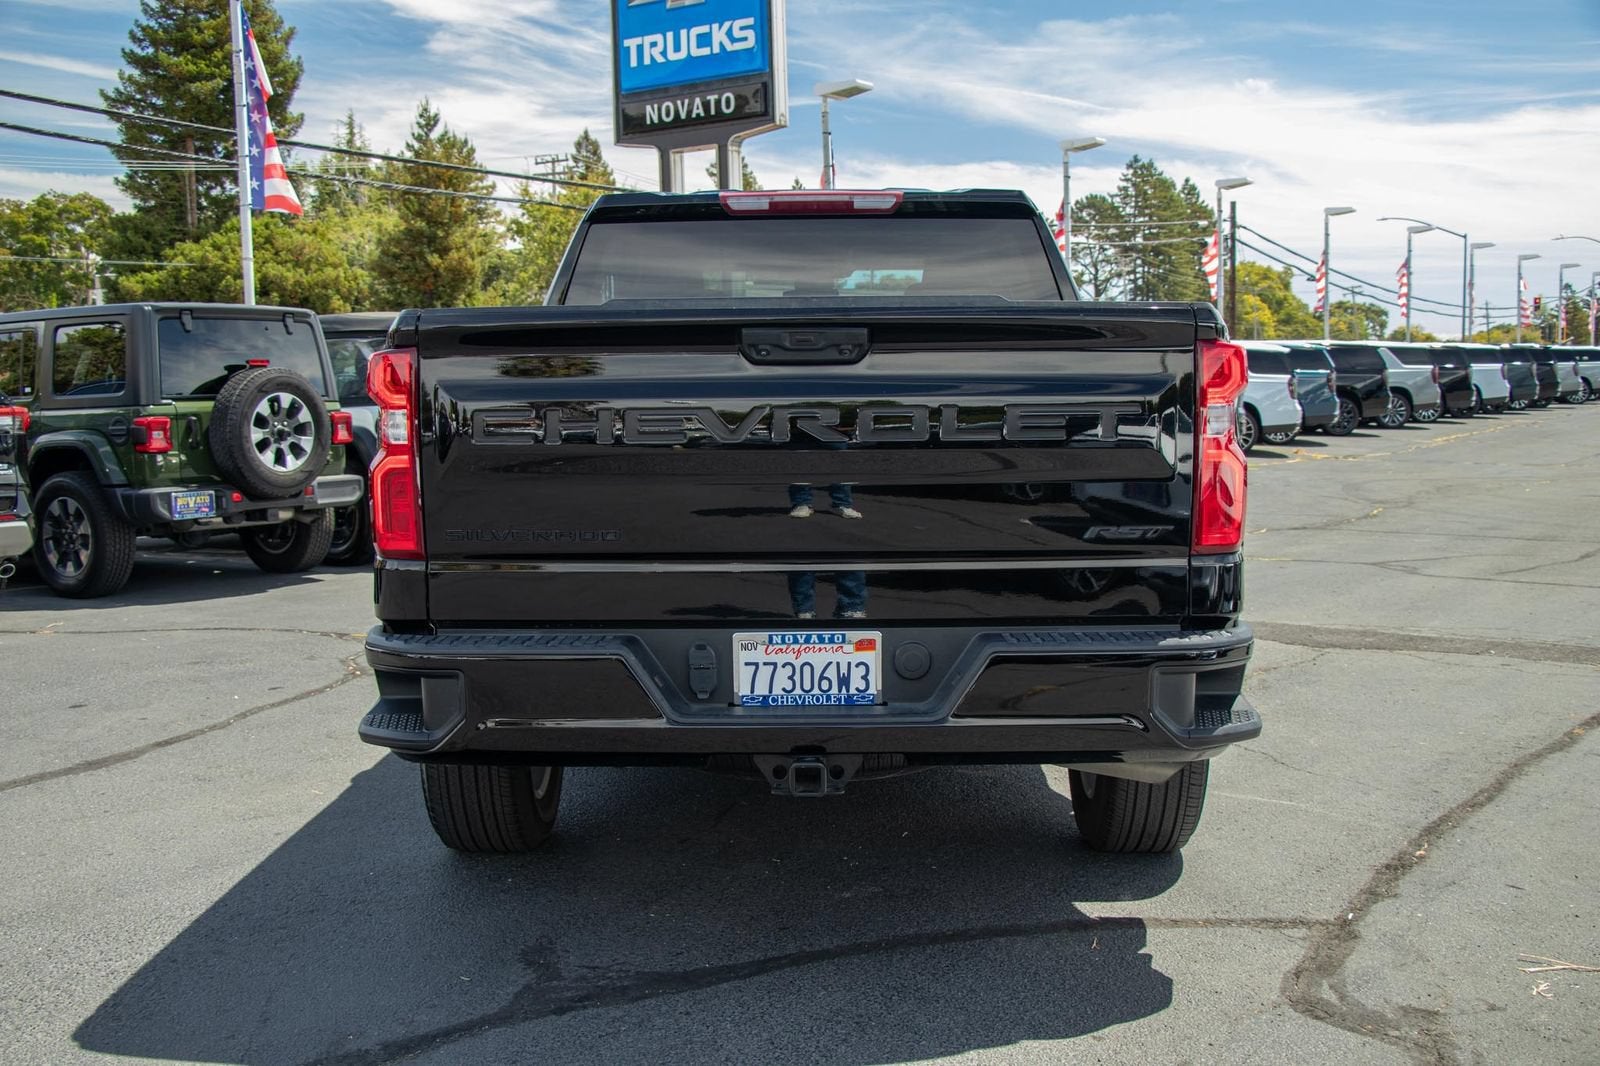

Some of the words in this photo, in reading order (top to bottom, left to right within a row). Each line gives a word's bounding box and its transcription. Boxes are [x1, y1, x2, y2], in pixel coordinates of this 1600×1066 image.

[623, 17, 756, 68] TRUCKS
[645, 92, 735, 124] NOVATO
[470, 402, 1143, 446] CHEVROLET
[446, 528, 623, 543] SILVERADO
[1083, 526, 1174, 539] RST
[740, 642, 758, 651] NOV
[772, 634, 842, 644] NOVATO
[764, 643, 854, 660] California
[744, 661, 870, 694] 77306W3
[768, 695, 847, 705] CHEVROLET
